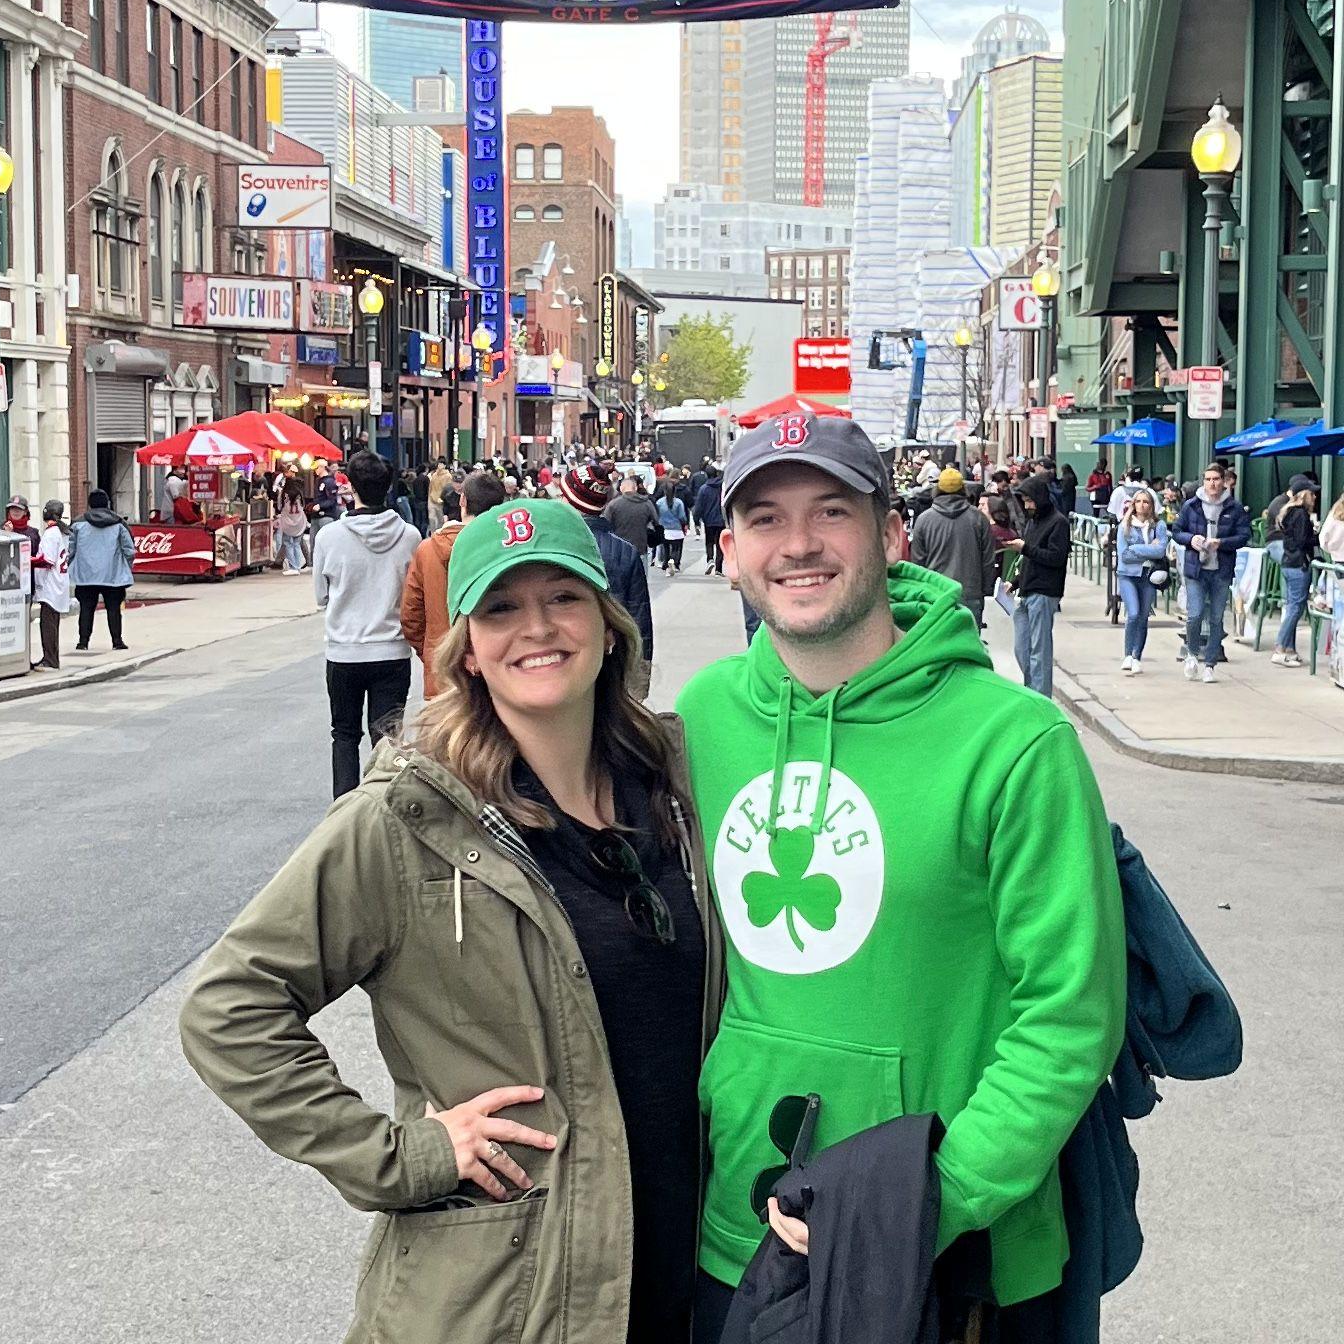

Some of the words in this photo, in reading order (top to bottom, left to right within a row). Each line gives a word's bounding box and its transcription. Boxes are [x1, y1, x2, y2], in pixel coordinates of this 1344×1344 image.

[552, 8, 612, 22] GATE
[623, 7, 640, 21] C
[469, 20, 498, 160] HOUSE
[241, 173, 329, 191] Souvenirs
[472, 173, 495, 192] of
[1005, 282, 1033, 292] GAT
[209, 286, 291, 321] SOUVENIRS
[1014, 296, 1037, 324] C
[771, 414, 810, 449] B
[497, 508, 536, 548] B
[134, 531, 176, 554] Cola
[726, 775, 870, 857] CETCS
